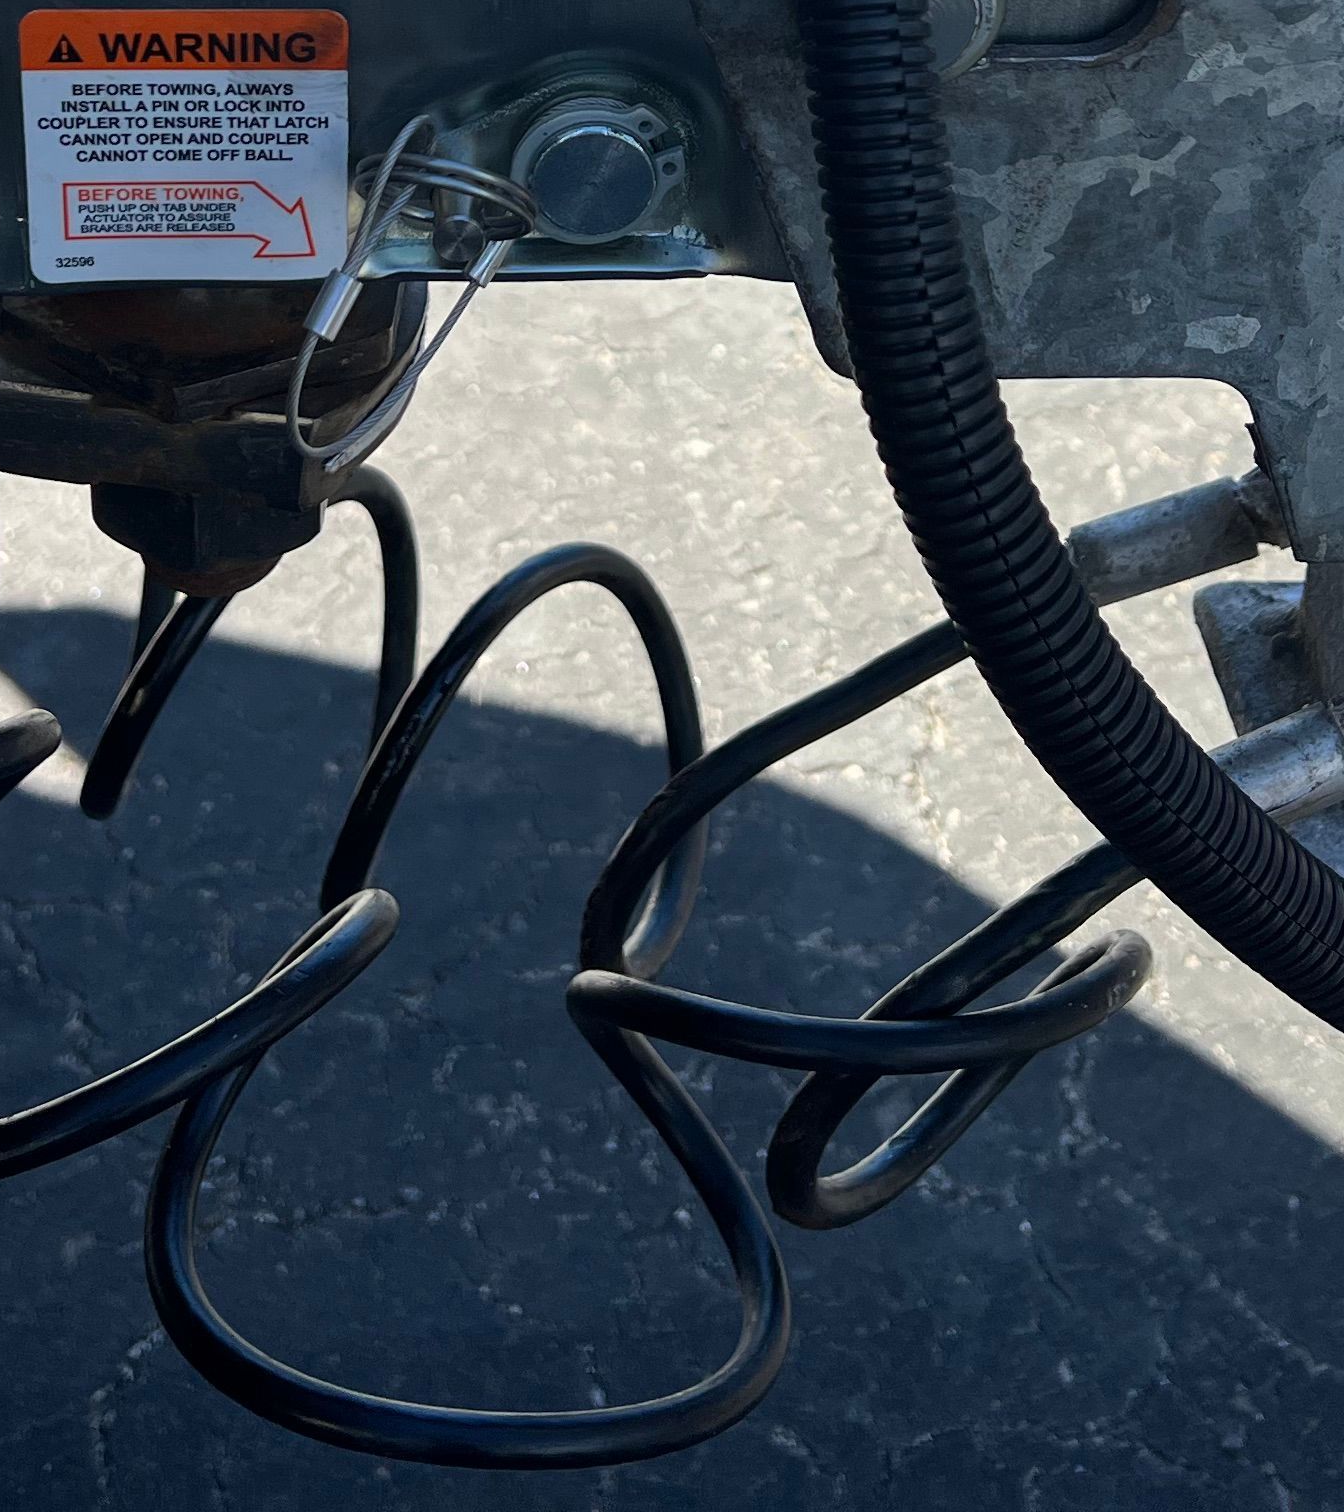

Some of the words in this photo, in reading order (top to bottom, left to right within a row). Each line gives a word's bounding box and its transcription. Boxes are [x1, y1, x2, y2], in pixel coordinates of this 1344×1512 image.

[98, 33, 316, 63] WARNING
[72, 84, 142, 96] BEFORE
[150, 84, 221, 97] TOWING,
[225, 83, 294, 96] ALWAYS
[61, 101, 132, 112] INSTALL
[135, 101, 147, 112] A
[152, 100, 179, 112] PIN
[184, 100, 208, 112] OR
[215, 100, 260, 112] LOCK
[266, 100, 305, 112] INTO
[37, 117, 121, 129] COUPLER
[125, 117, 147, 129] TO
[153, 117, 221, 129] ENSURE
[229, 116, 270, 128] THAT
[275, 116, 329, 128] LATCH
[59, 134, 130, 145] CANNOT
[137, 133, 184, 145] OPEN
[187, 133, 224, 145] AND
[229, 133, 309, 145] COUPLER
[76, 150, 145, 162] CANNOT
[154, 150, 202, 162] COME
[207, 149, 239, 161] OFF
[246, 149, 293, 161] BALL.
[78, 188, 155, 201] BEFORE
[164, 188, 244, 202] TOWING,
[78, 203, 115, 212] PUSH
[119, 203, 137, 212] UP
[142, 203, 159, 212] ON
[163, 203, 188, 212] TAB
[191, 202, 236, 212] UNDER
[84, 213, 156, 222] ACTUATOR
[158, 213, 175, 222] TO
[177, 212, 231, 222] ASSURE
[80, 223, 134, 233] BRAKES
[136, 223, 163, 232] ARE
[167, 222, 235, 232] RELEASED
[55, 257, 94, 267] 32596
